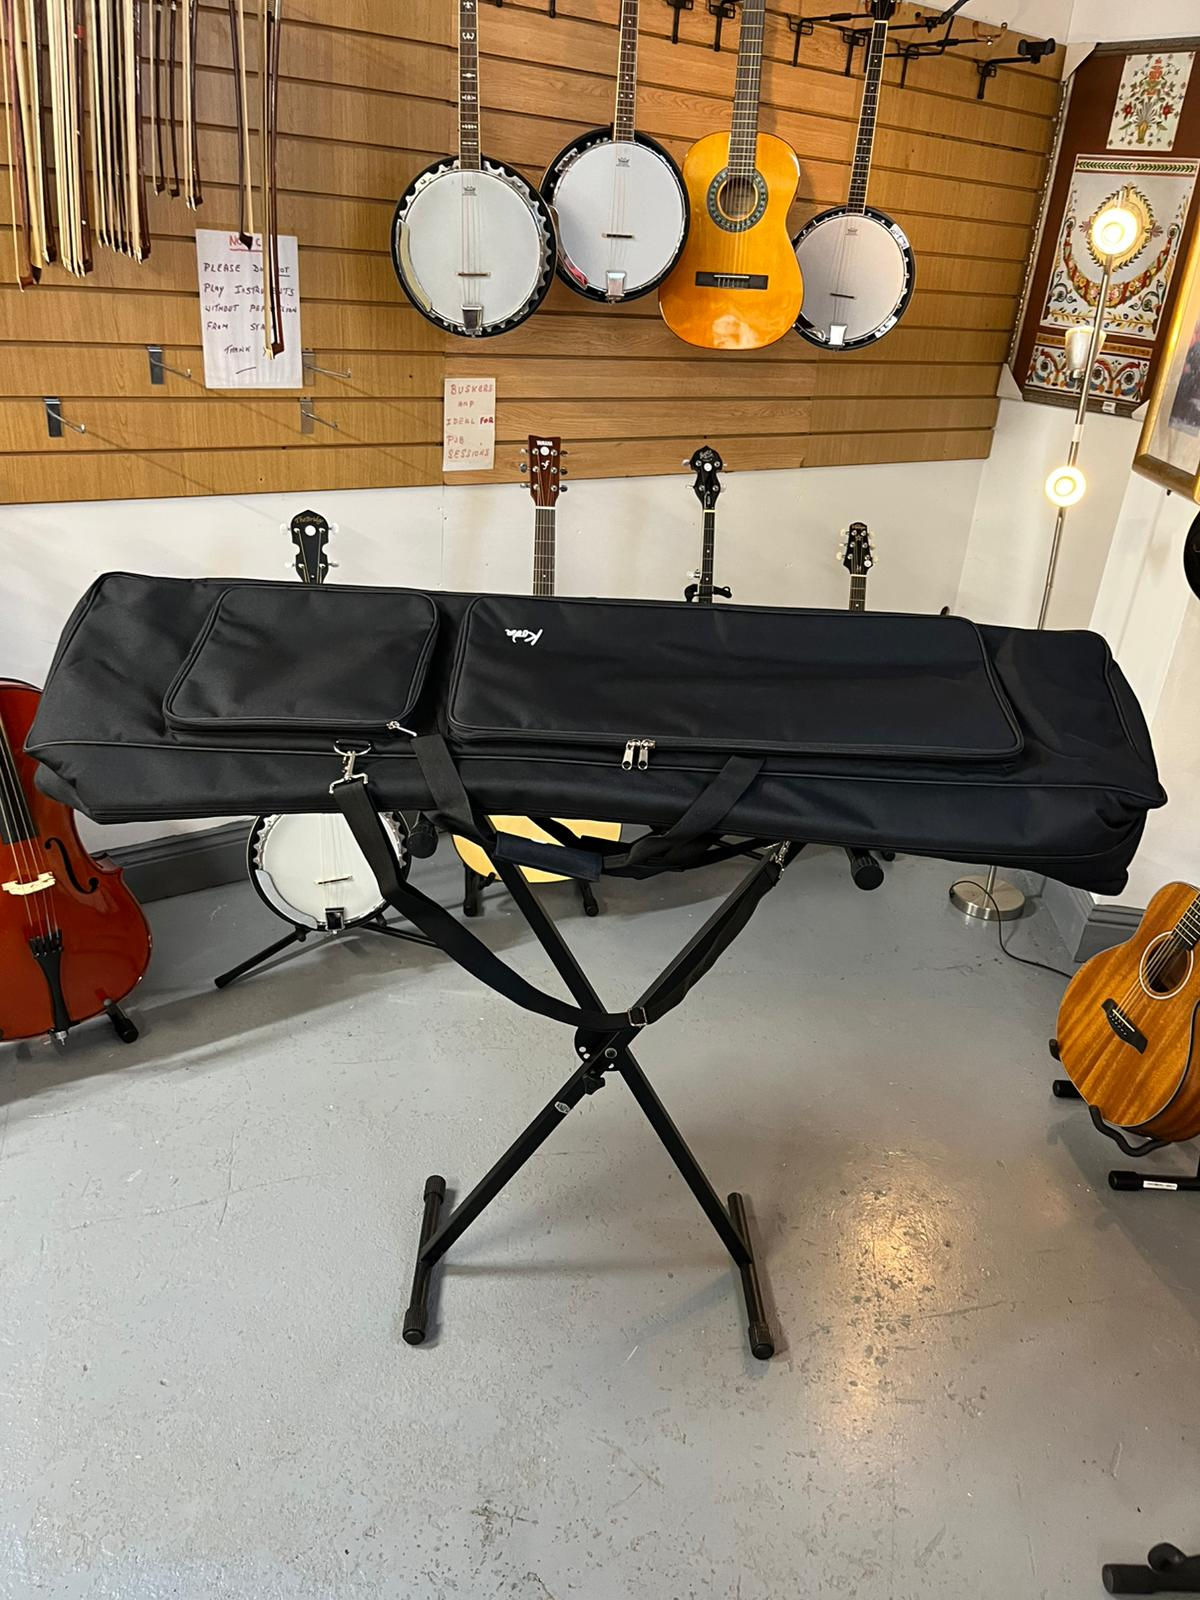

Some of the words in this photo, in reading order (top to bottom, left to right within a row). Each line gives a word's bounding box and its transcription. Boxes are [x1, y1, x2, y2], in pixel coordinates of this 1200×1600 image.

[203, 262, 241, 273] PLEASE
[234, 284, 295, 297] INSTRUETS
[205, 304, 240, 313] WITHOUT
[206, 323, 229, 331] FROM
[249, 322, 274, 332] STA
[224, 344, 252, 354] THANK
[450, 384, 493, 395] BUSKERS
[446, 417, 476, 426] IDEAL
[479, 416, 494, 425] FOR
[447, 435, 465, 446] PUB
[448, 447, 490, 459] SESSIONS
